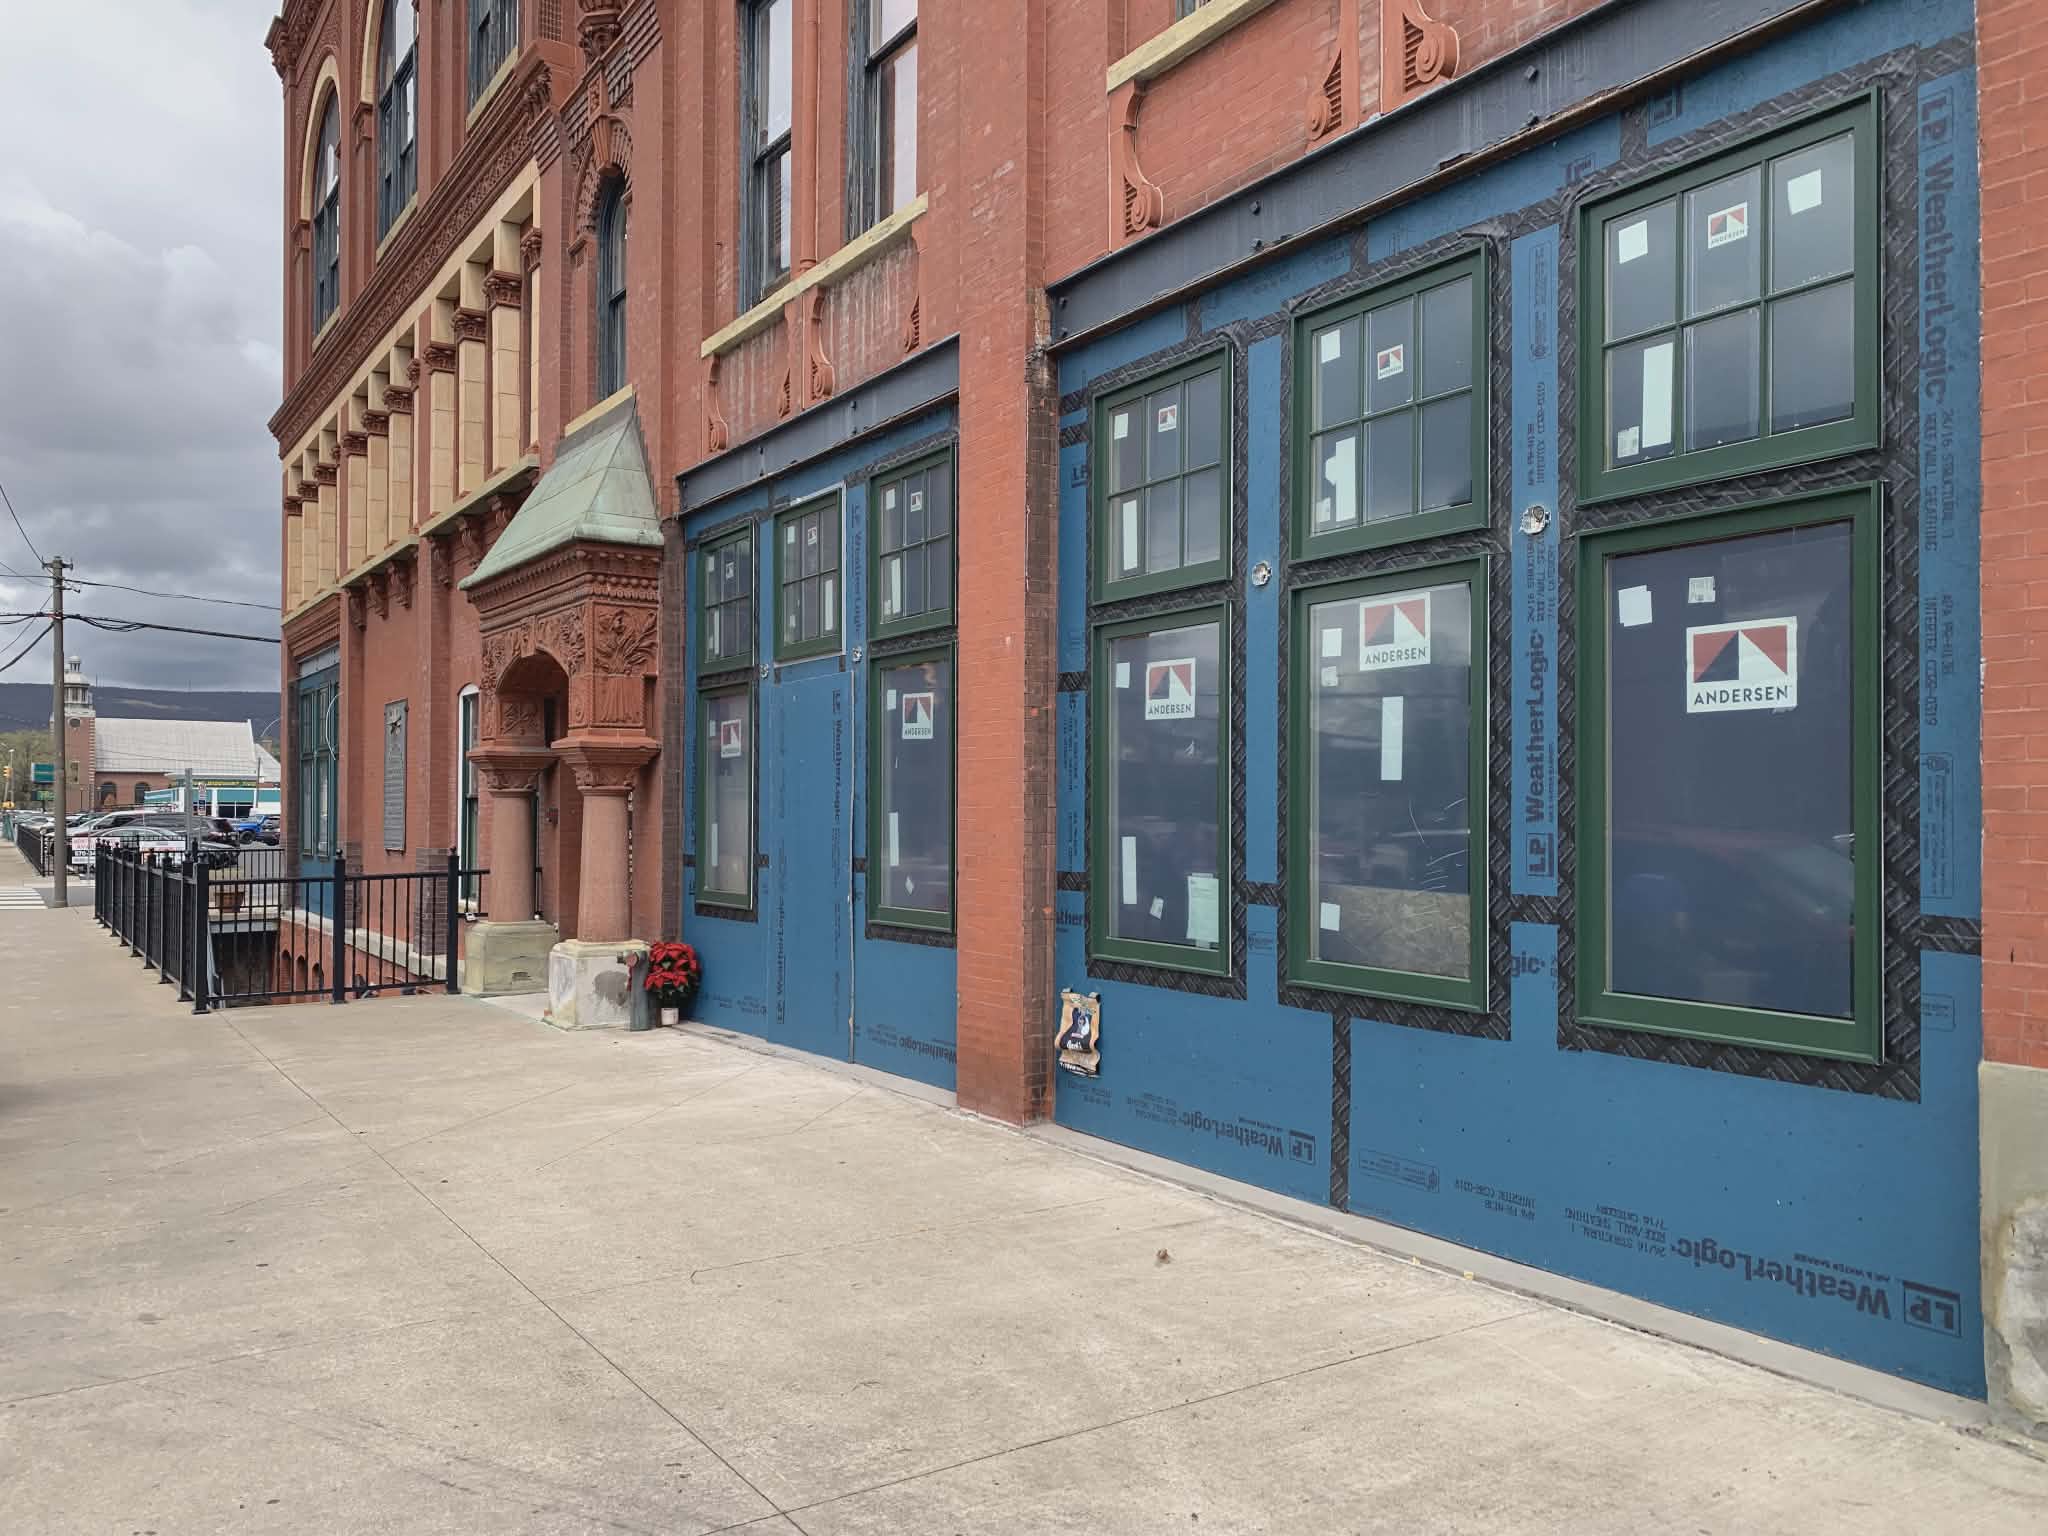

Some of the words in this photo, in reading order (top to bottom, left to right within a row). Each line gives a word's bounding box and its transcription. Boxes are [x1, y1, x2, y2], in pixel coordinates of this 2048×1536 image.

[1919, 154, 1955, 400] WeatherLogic
[1365, 647, 1426, 665] ANDERSEN
[1148, 703, 1192, 715] ANDERSEN
[1694, 685, 1789, 706] ANDERSEN
[1525, 629, 1549, 824] WeatherLogic
[1527, 837, 1546, 873] LP
[1182, 1112, 1285, 1159] WeatherLogic
[1673, 1238, 1892, 1321] WeatherLogic
[1910, 1296, 1954, 1331] LP
